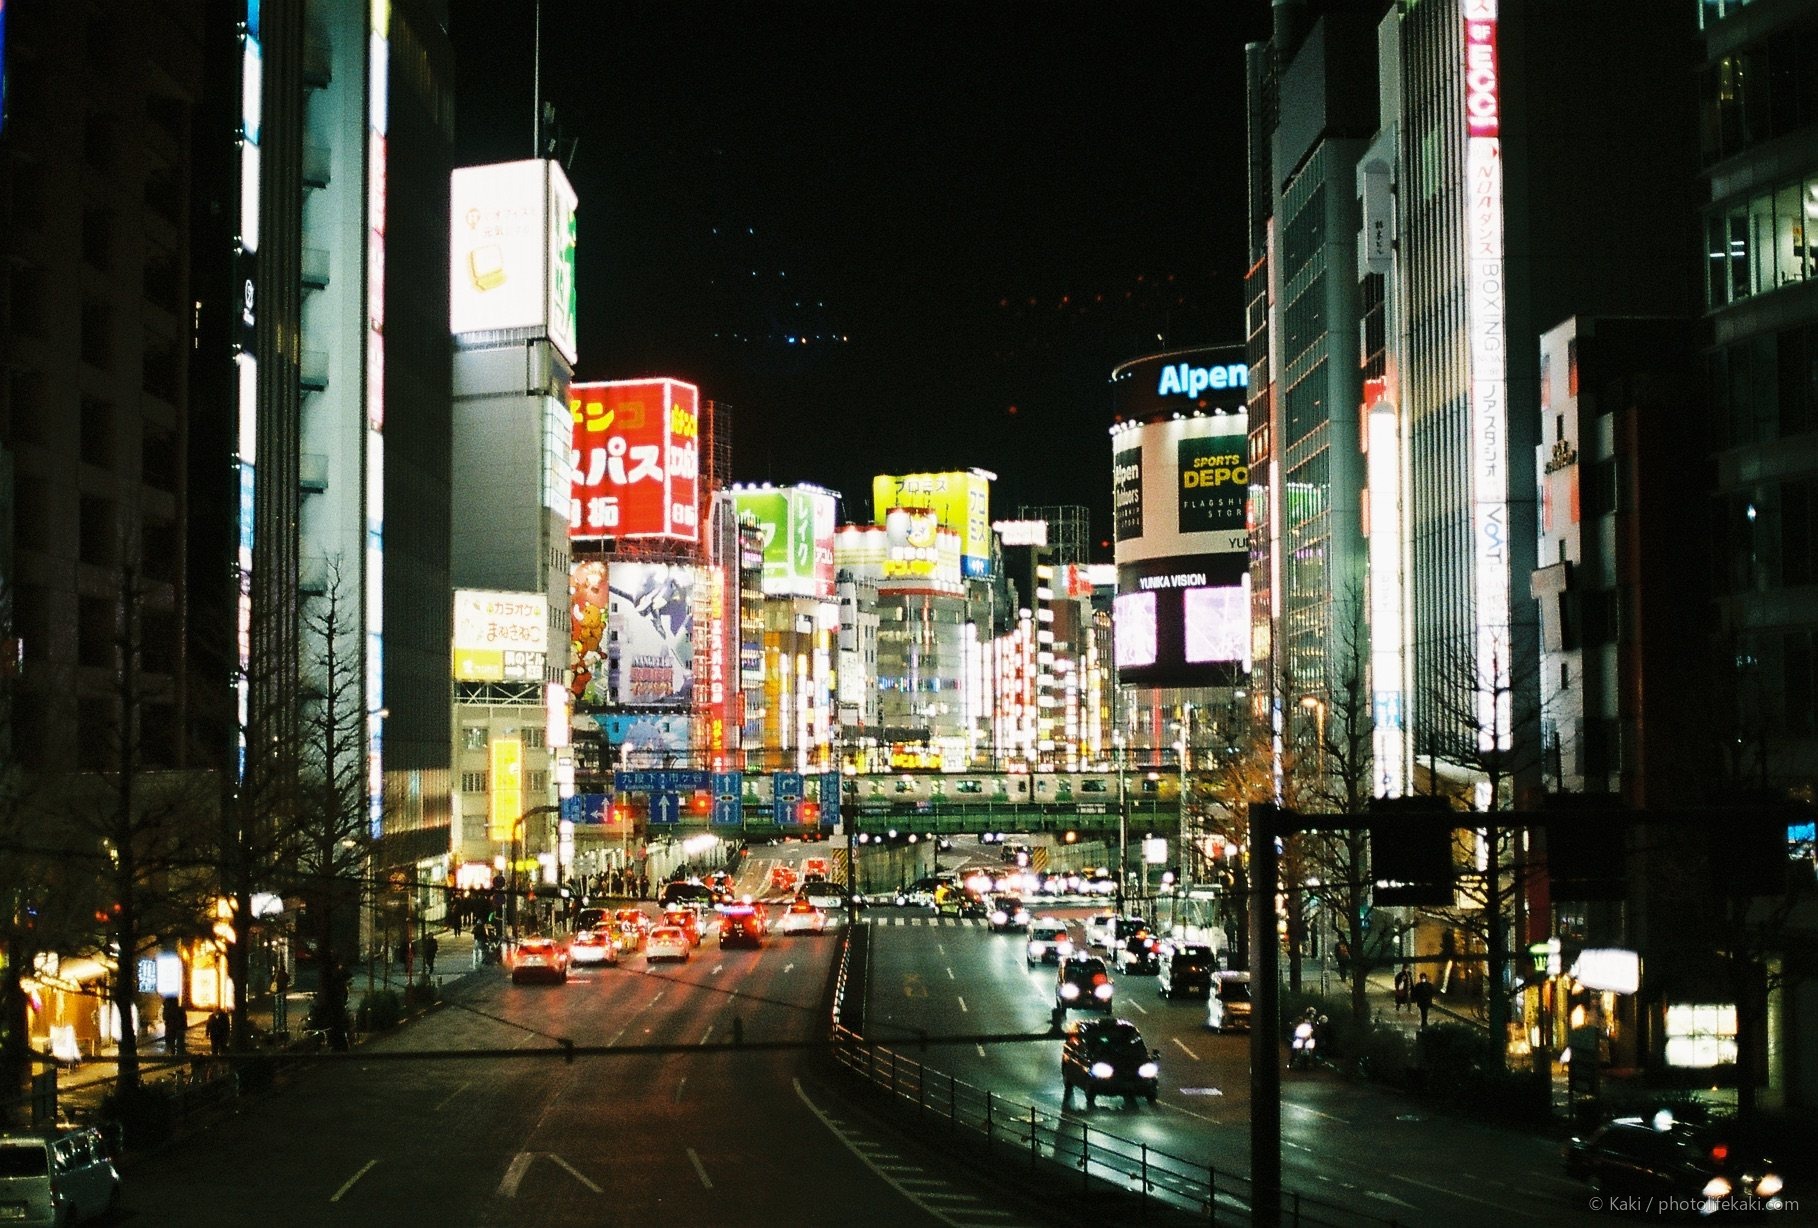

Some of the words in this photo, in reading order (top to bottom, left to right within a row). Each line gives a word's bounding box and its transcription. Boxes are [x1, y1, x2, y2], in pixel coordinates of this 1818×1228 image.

[1482, 263, 1500, 352] BOXING
[1158, 364, 1248, 398] Alpen
[1193, 454, 1240, 468] SPORTS
[797, 497, 809, 567] レイク
[1140, 577, 1170, 590] YUNIKA
[1171, 573, 1206, 587] VISION
[494, 602, 534, 616] カラオケ
[486, 622, 541, 642] まねきねこ
[622, 773, 656, 783] 九段下
